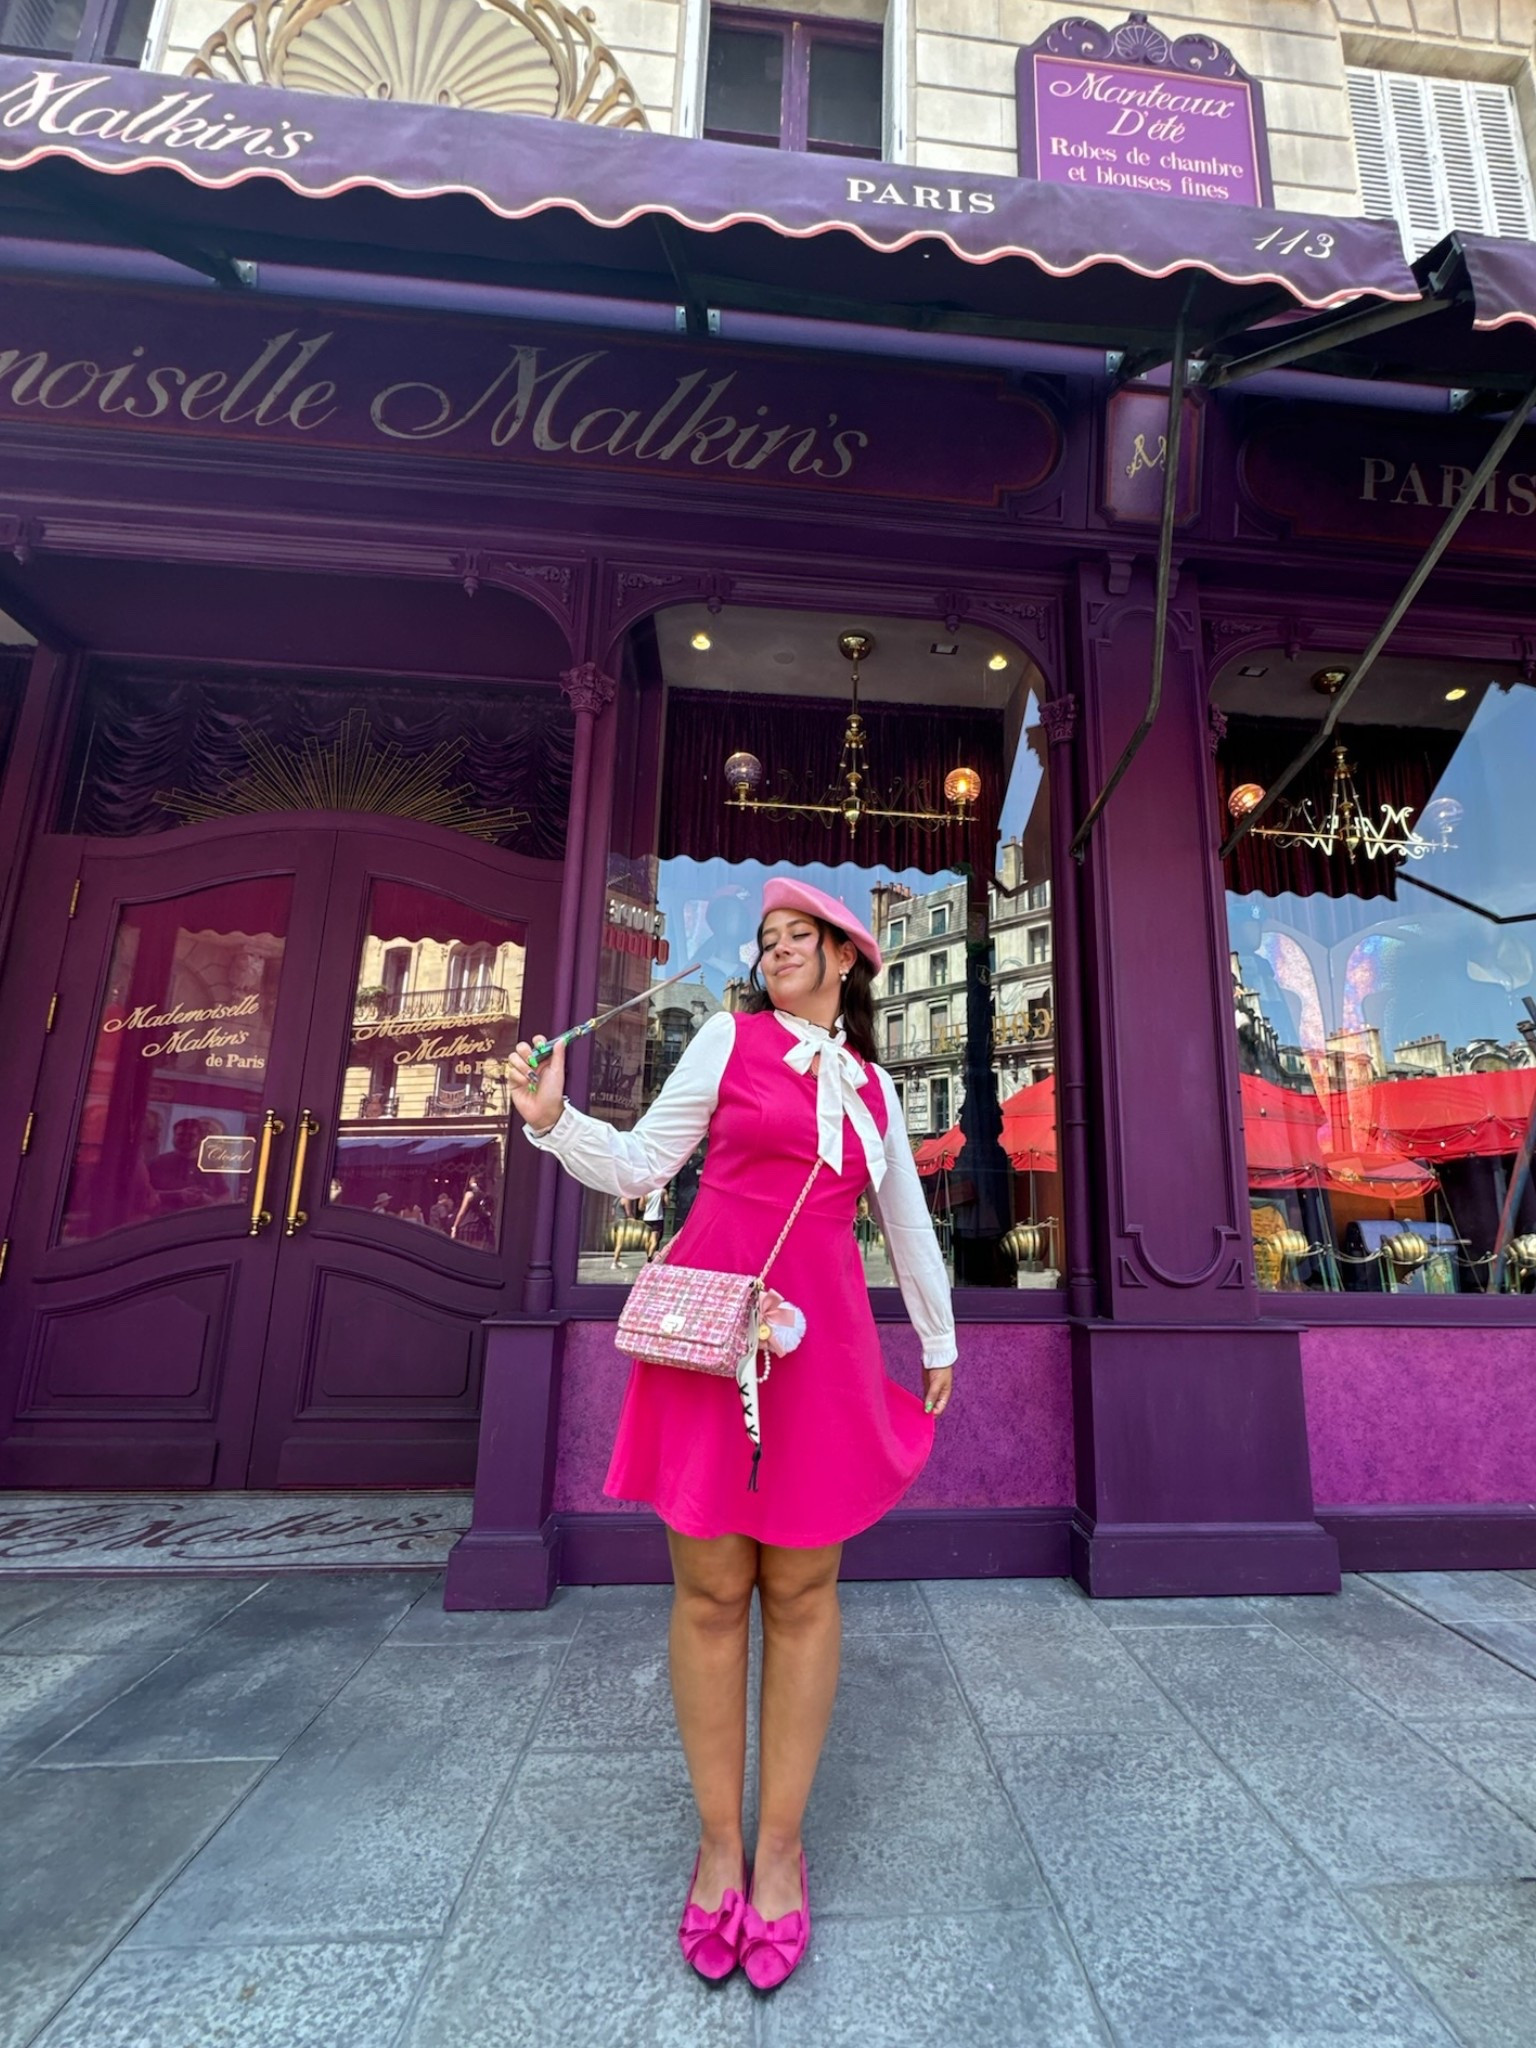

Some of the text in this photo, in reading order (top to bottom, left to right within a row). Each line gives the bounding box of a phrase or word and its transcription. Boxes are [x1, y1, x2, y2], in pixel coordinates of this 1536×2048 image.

[0, 70, 314, 159] Malkin's
[1048, 72, 1235, 119] Manteaux
[1049, 136, 1244, 179] Robes de chambre
[846, 177, 996, 215] PARIS
[1067, 166, 1229, 200] et blouses fines
[1253, 226, 1335, 259] 113
[369, 344, 868, 478] Malkin's
[1359, 456, 1536, 517] PARIS
[103, 993, 260, 1033] Mademoiselle
[141, 1026, 250, 1058] Malkin's
[393, 1033, 496, 1065] Malkin's
[205, 1054, 265, 1069] de Paris
[455, 1060, 471, 1075] de
